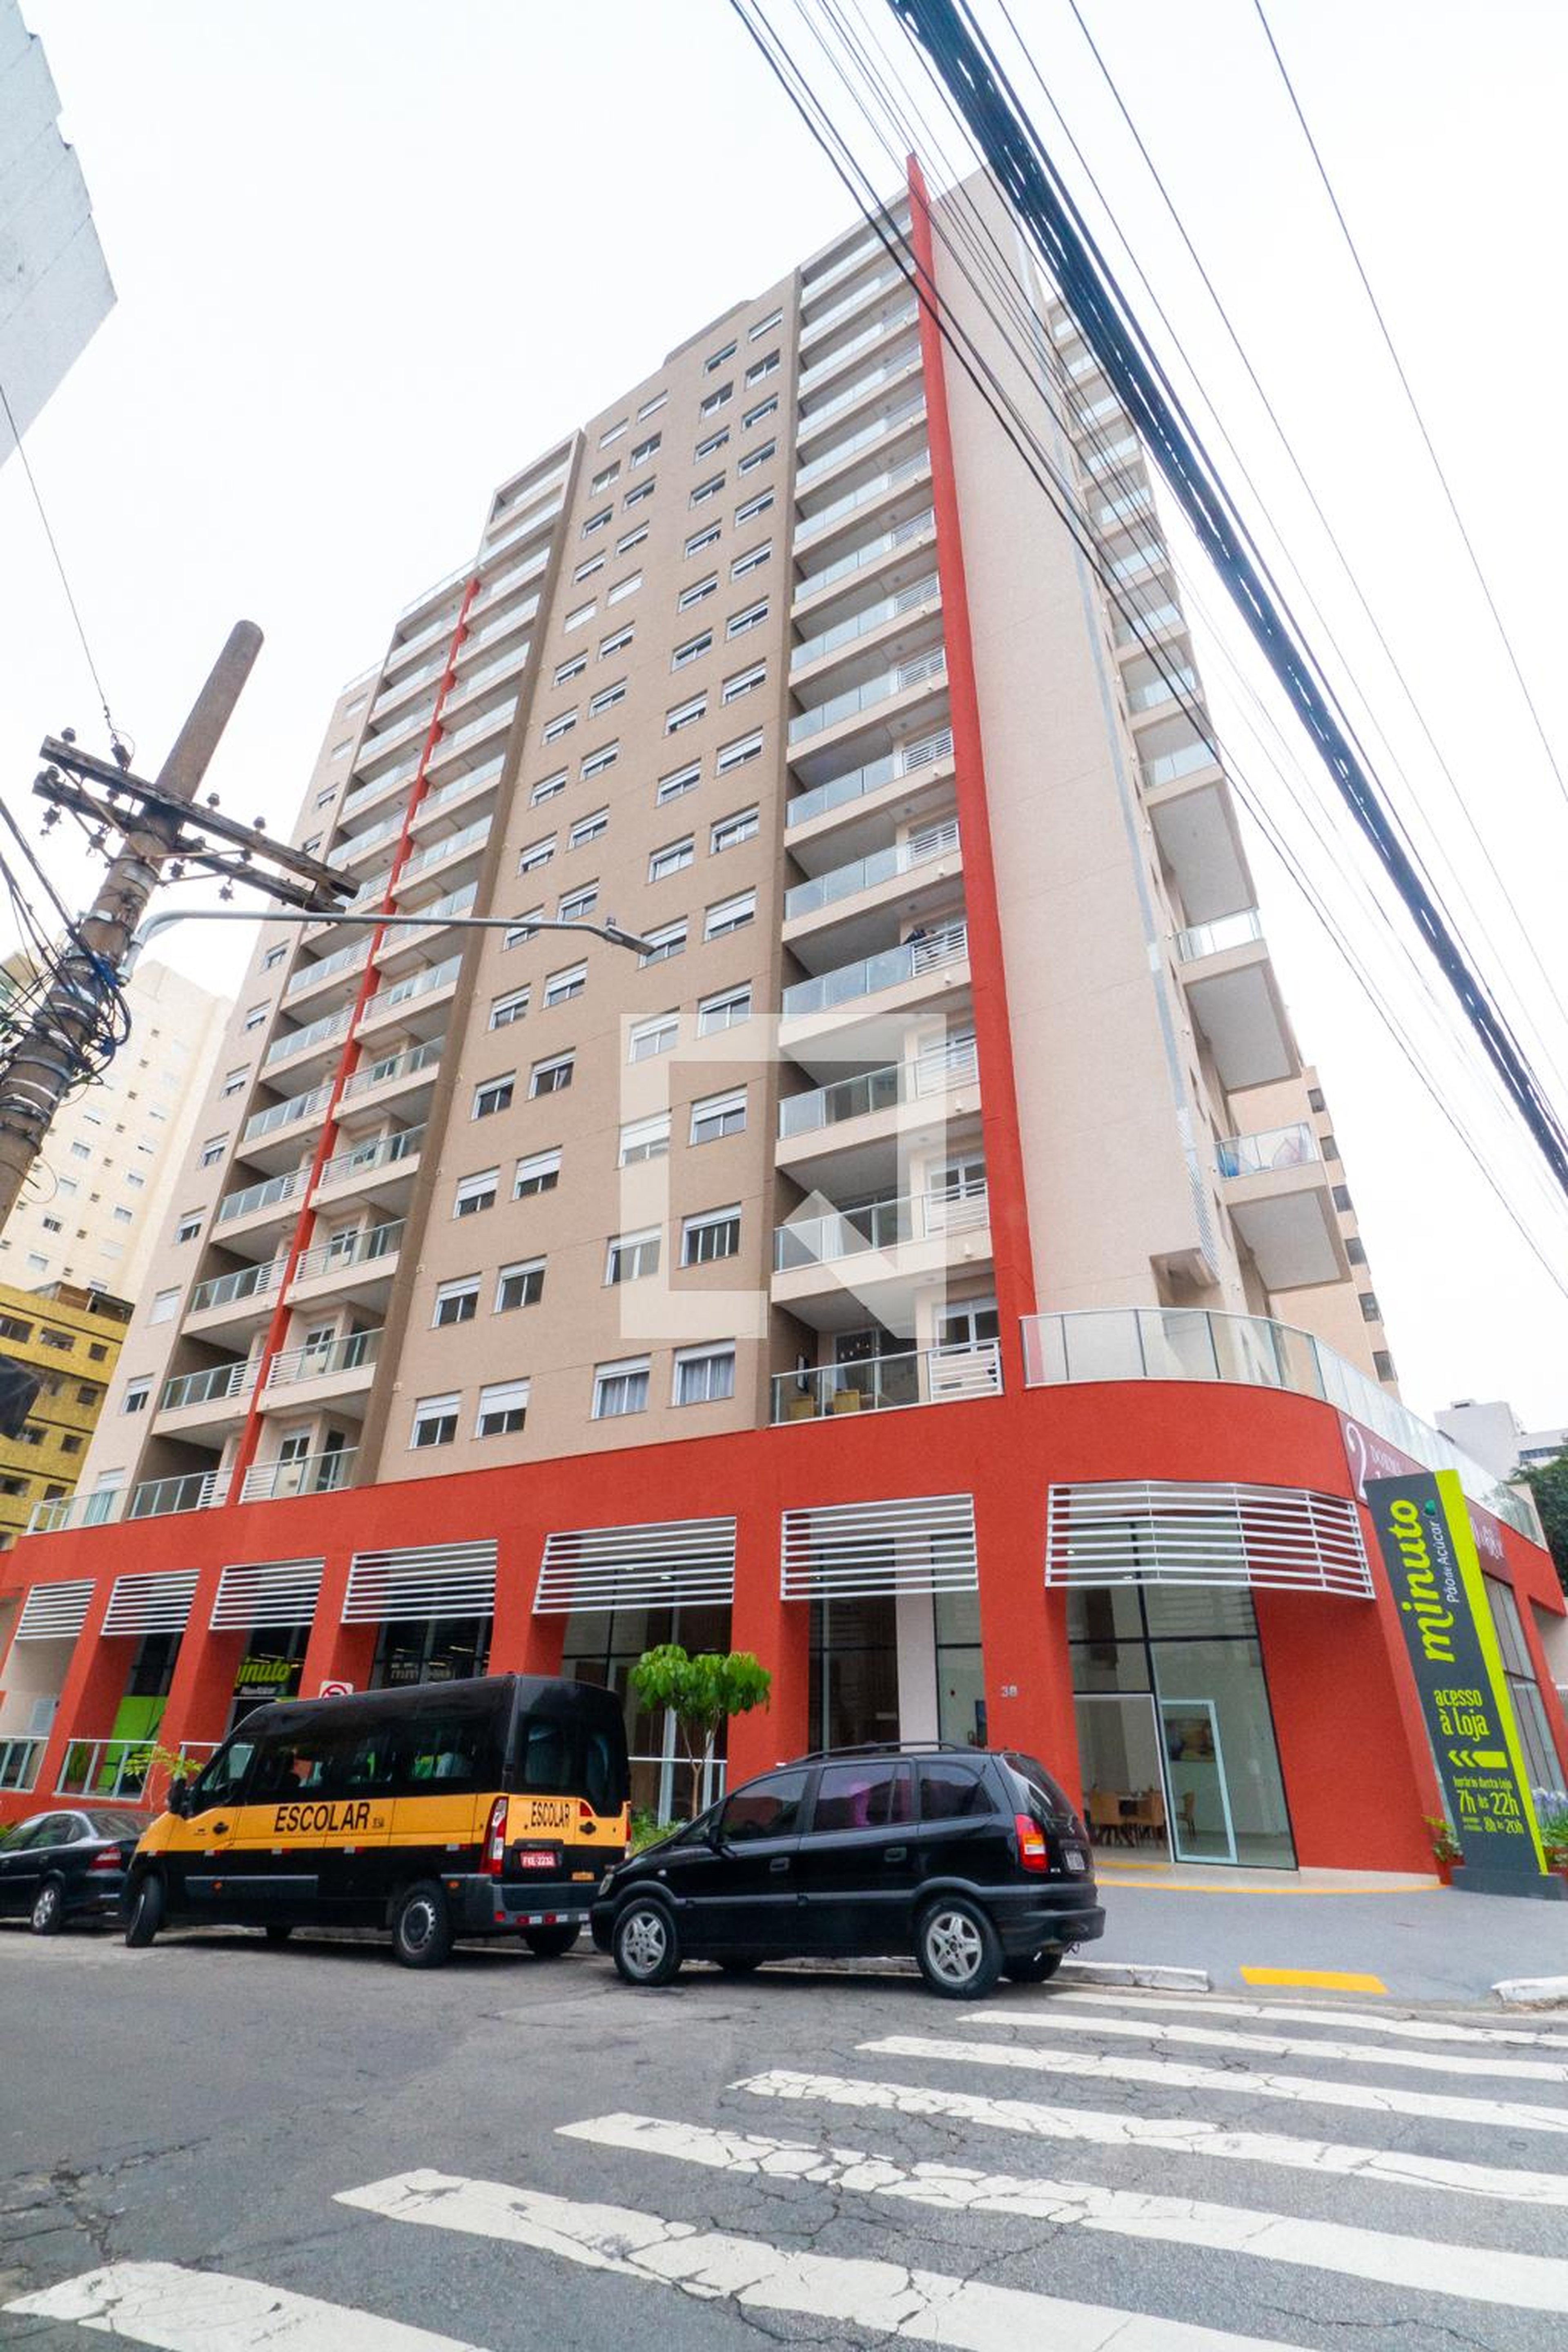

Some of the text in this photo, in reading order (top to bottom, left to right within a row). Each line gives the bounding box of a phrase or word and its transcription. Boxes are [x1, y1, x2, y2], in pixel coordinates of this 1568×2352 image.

[1388, 1499, 1455, 1662] minuto
[1434, 1690, 1483, 1707] acesso
[1439, 1706, 1490, 1742] à loja
[531, 1801, 570, 1829] ESCOLAR
[1457, 1789, 1477, 1814] 7h
[1490, 1789, 1520, 1816] 22h
[274, 1802, 370, 1833] ESCOLAR
[1504, 1818, 1524, 1834] 20h
